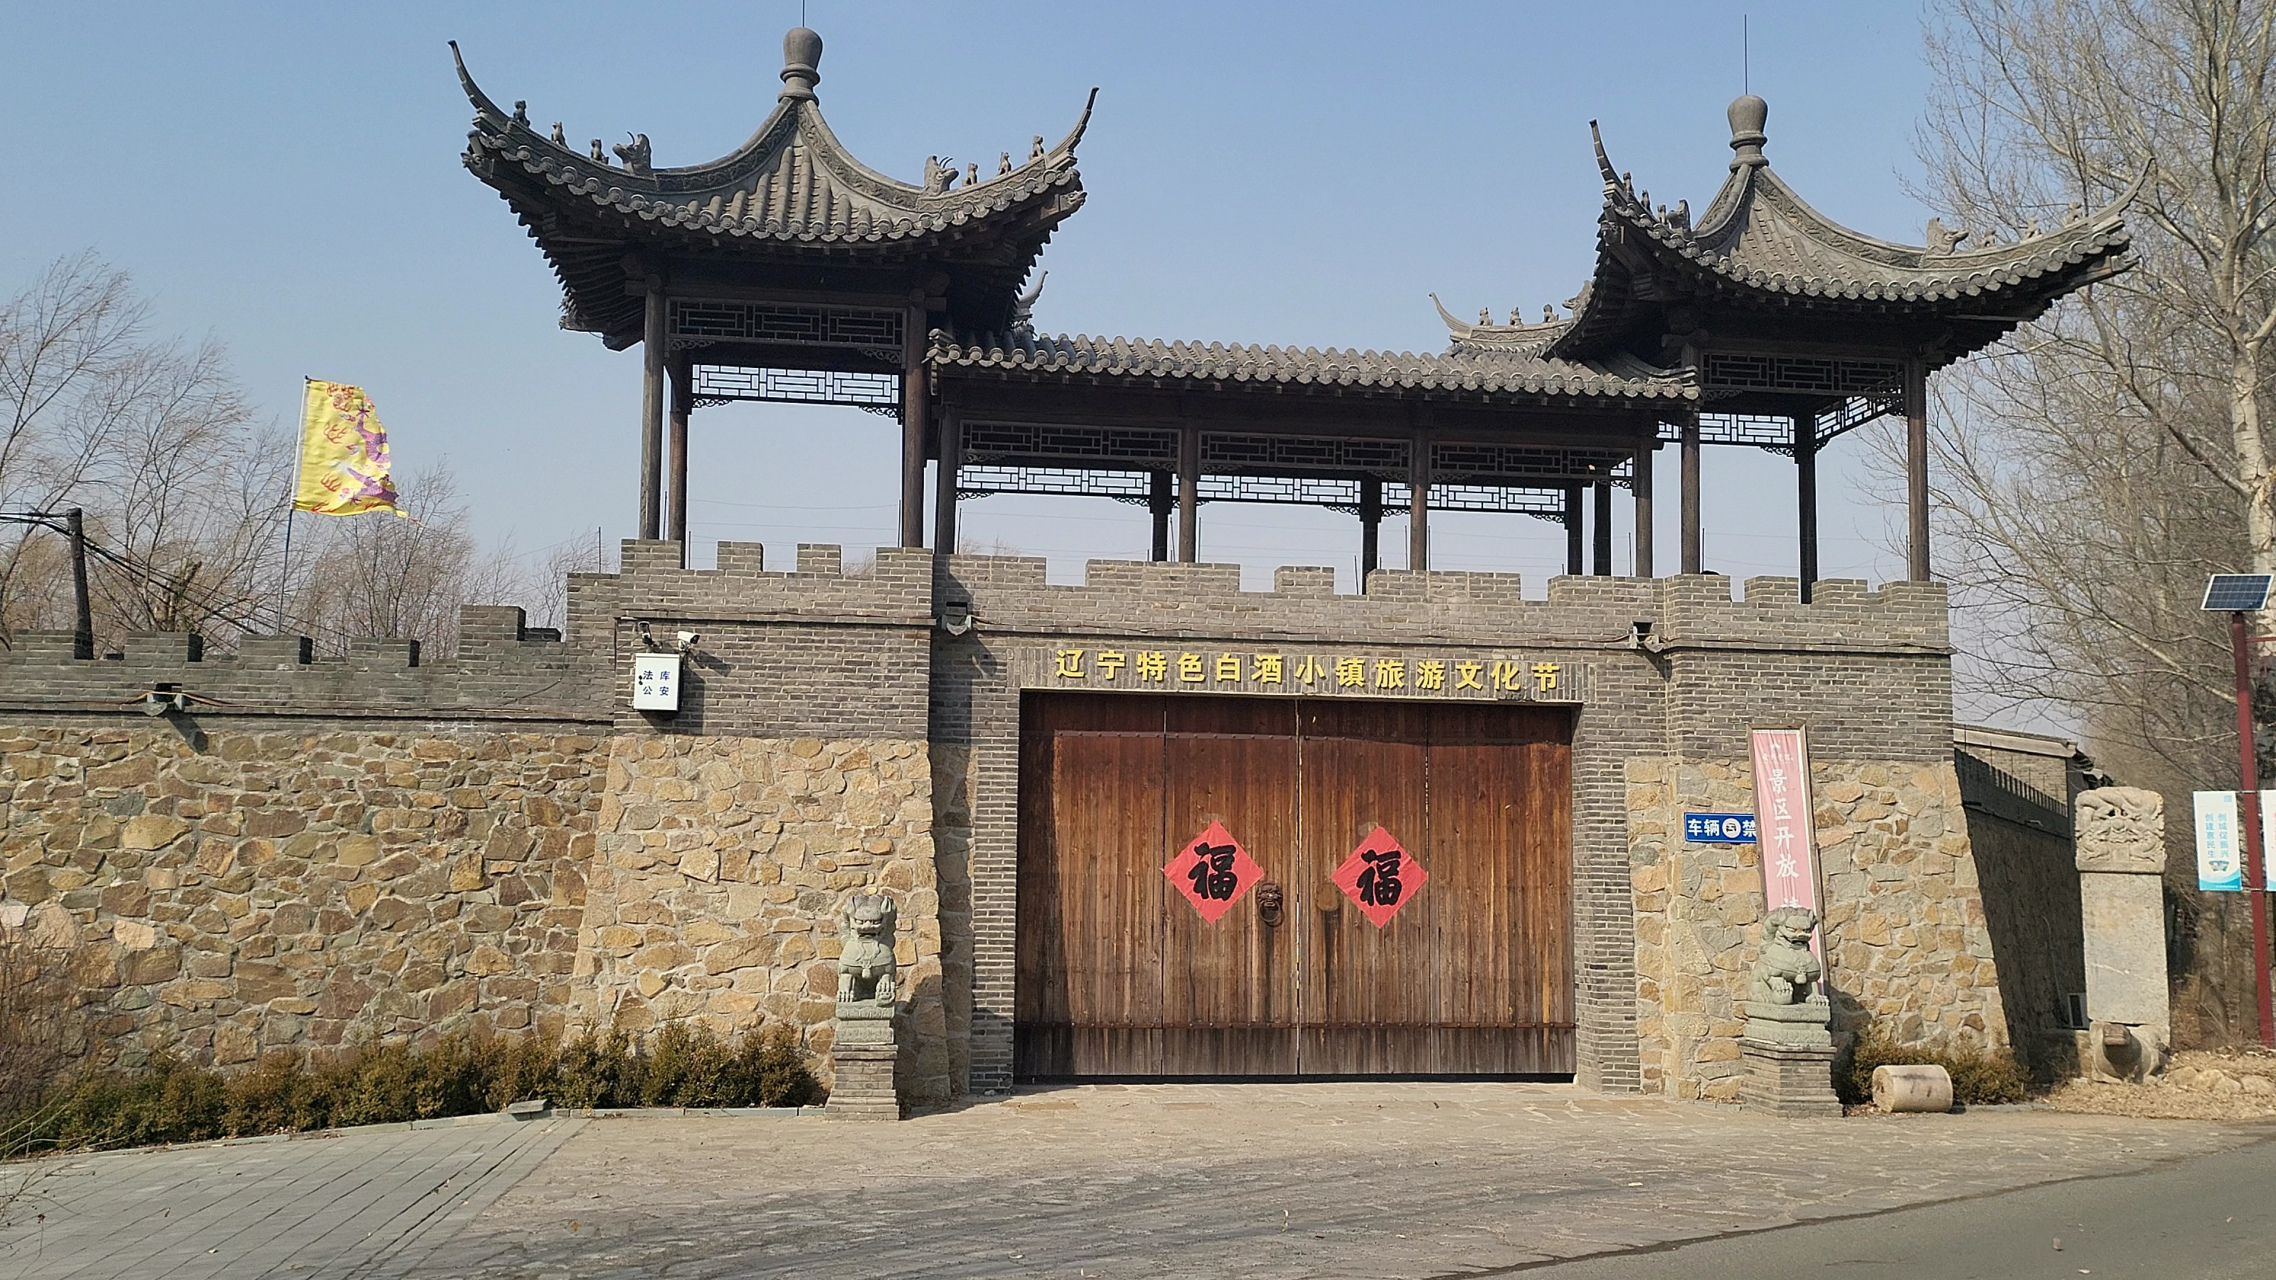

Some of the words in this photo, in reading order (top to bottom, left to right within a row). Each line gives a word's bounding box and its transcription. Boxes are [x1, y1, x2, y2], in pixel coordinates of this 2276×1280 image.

[642, 686, 669, 696] 公安
[643, 670, 670, 681] 法库
[1055, 650, 1561, 692] 辽宁特色白酒小镇旅游文化节
[1687, 818, 1720, 837] 车辆
[1768, 768, 1799, 878] 景区开放
[1188, 842, 1238, 901] 福
[1356, 850, 1402, 906] 福
